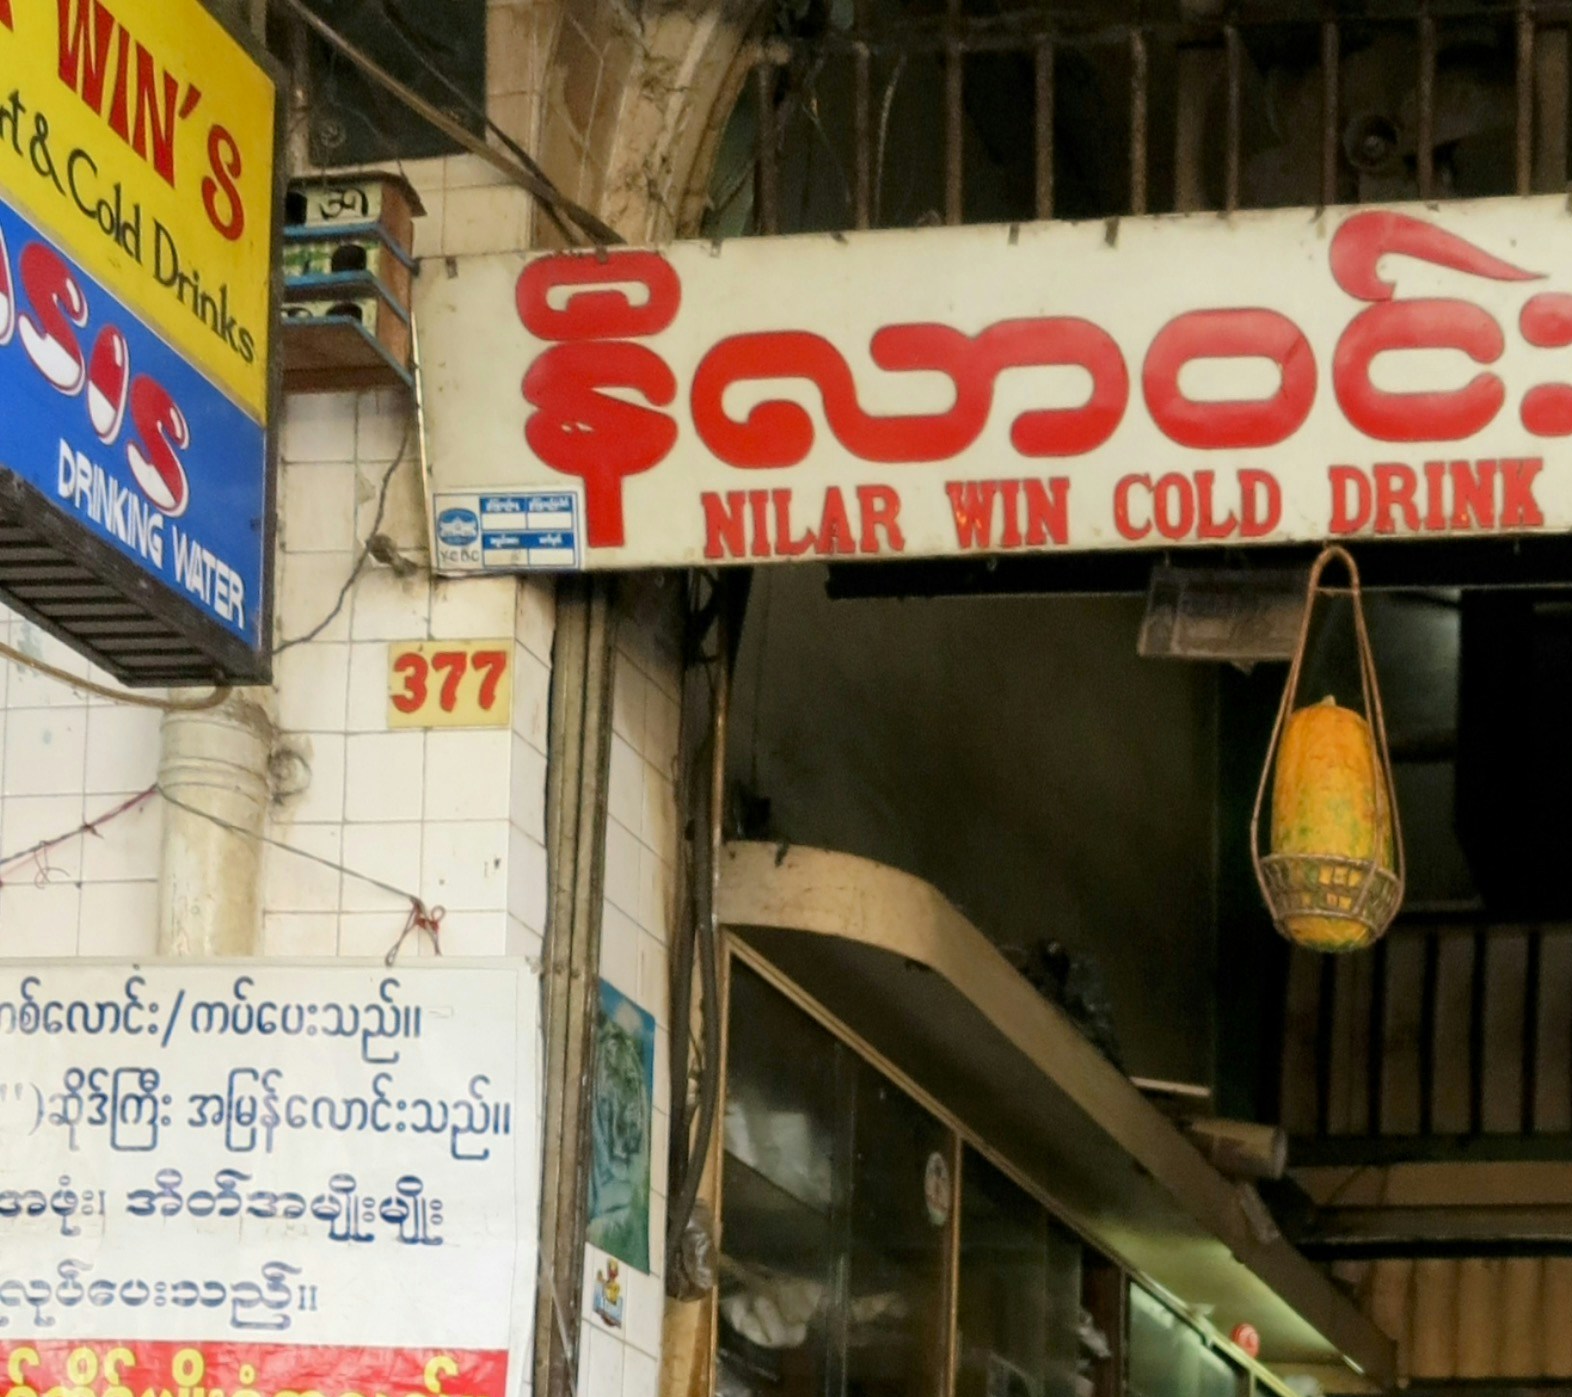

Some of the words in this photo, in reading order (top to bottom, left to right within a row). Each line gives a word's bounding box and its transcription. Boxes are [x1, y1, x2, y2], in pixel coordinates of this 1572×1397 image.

[67, 148, 142, 266] Cold
[153, 216, 256, 365] Drinks
[57, 437, 165, 570] DRINKING
[171, 524, 246, 631] WATER
[701, 484, 905, 559] NILAR
[945, 477, 1071, 550] WIN
[1114, 467, 1282, 540] COLD
[1328, 457, 1544, 535] DRINK
[390, 649, 507, 714] 377
